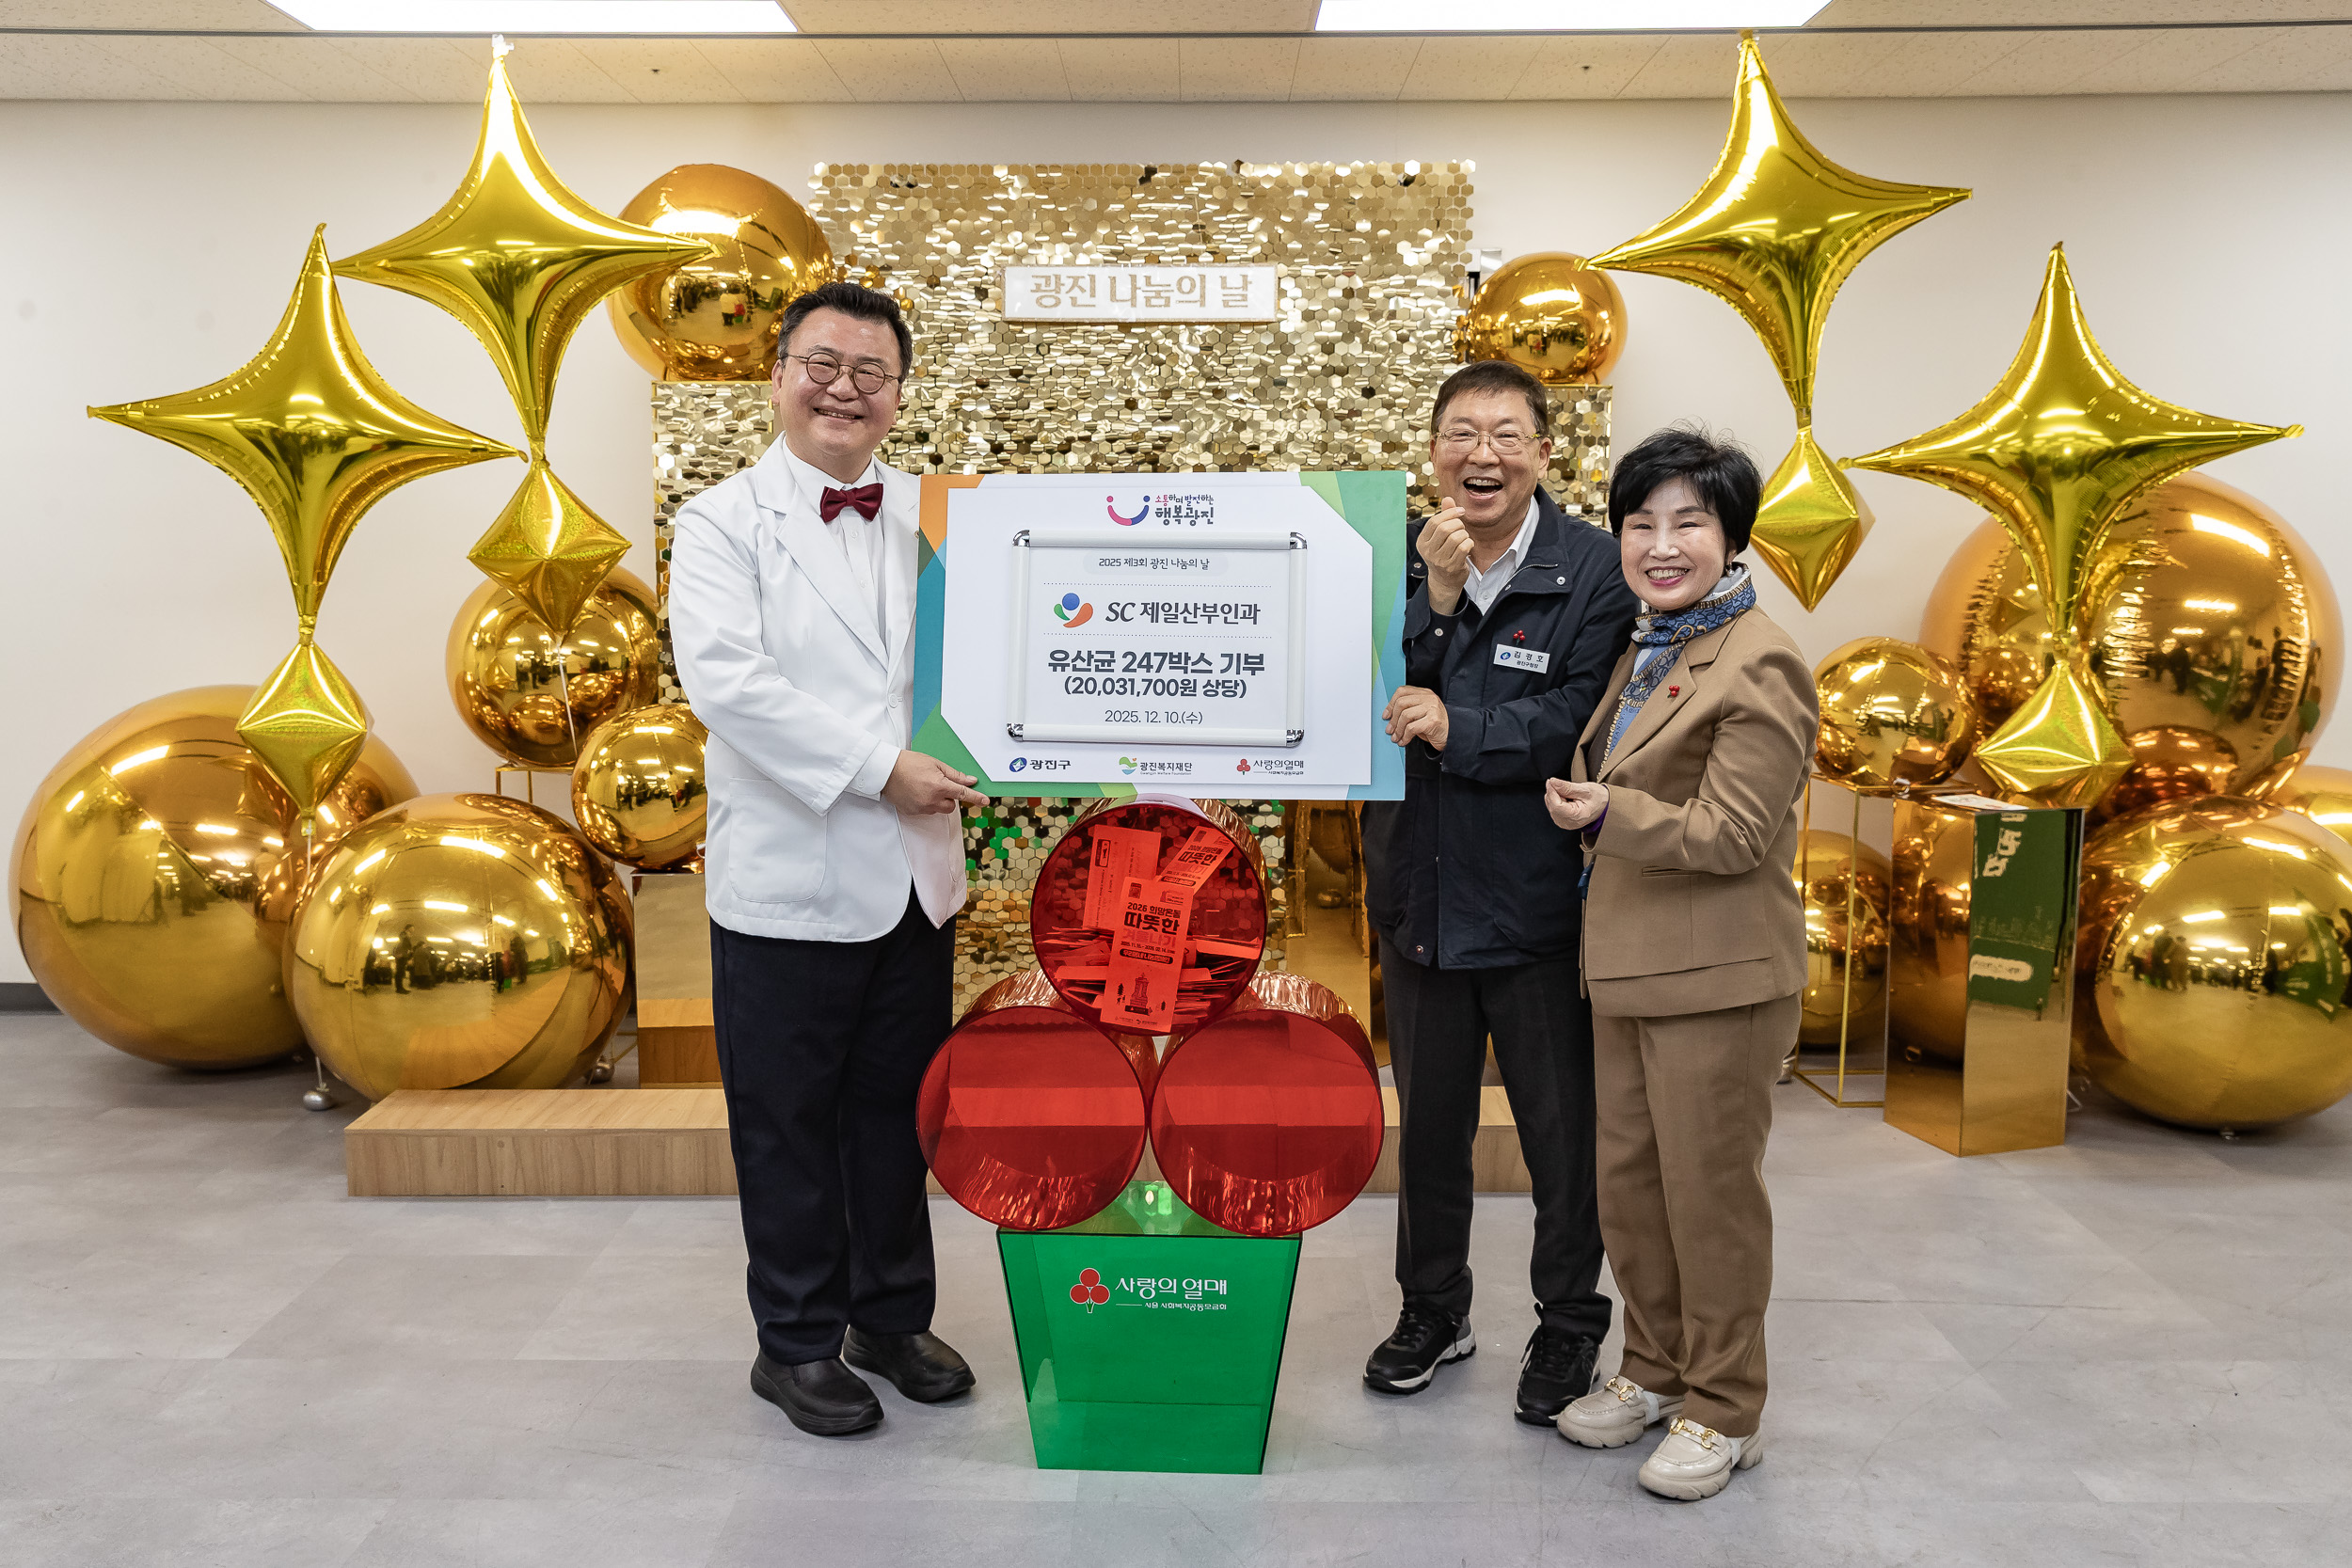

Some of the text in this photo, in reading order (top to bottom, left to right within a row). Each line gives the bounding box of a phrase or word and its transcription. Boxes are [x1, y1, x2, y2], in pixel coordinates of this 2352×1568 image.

[1030, 274, 1252, 308] 광진 나눔의 날
[1155, 494, 1214, 507] 소통하며 발전하는
[1155, 505, 1214, 526] 행복광진
[1099, 558, 1210, 570] 2025 제3회 광진 나눔의 날
[1105, 602, 1261, 625] SC 제일산부인과
[1048, 649, 1265, 675] 유산균 247박스 기부
[1064, 675, 1247, 699] (20,031,700원 상당)
[1104, 709, 1203, 724] 2025. 12. 10.(수)
[1029, 759, 1072, 770] 광진구
[1140, 762, 1192, 771] 광진복지재단
[1178, 851, 1217, 865] 따뜻한
[1127, 902, 1148, 912] 2026
[1124, 911, 1180, 935] 따뜻한
[1115, 1277, 1227, 1300] 사랑의 열매
